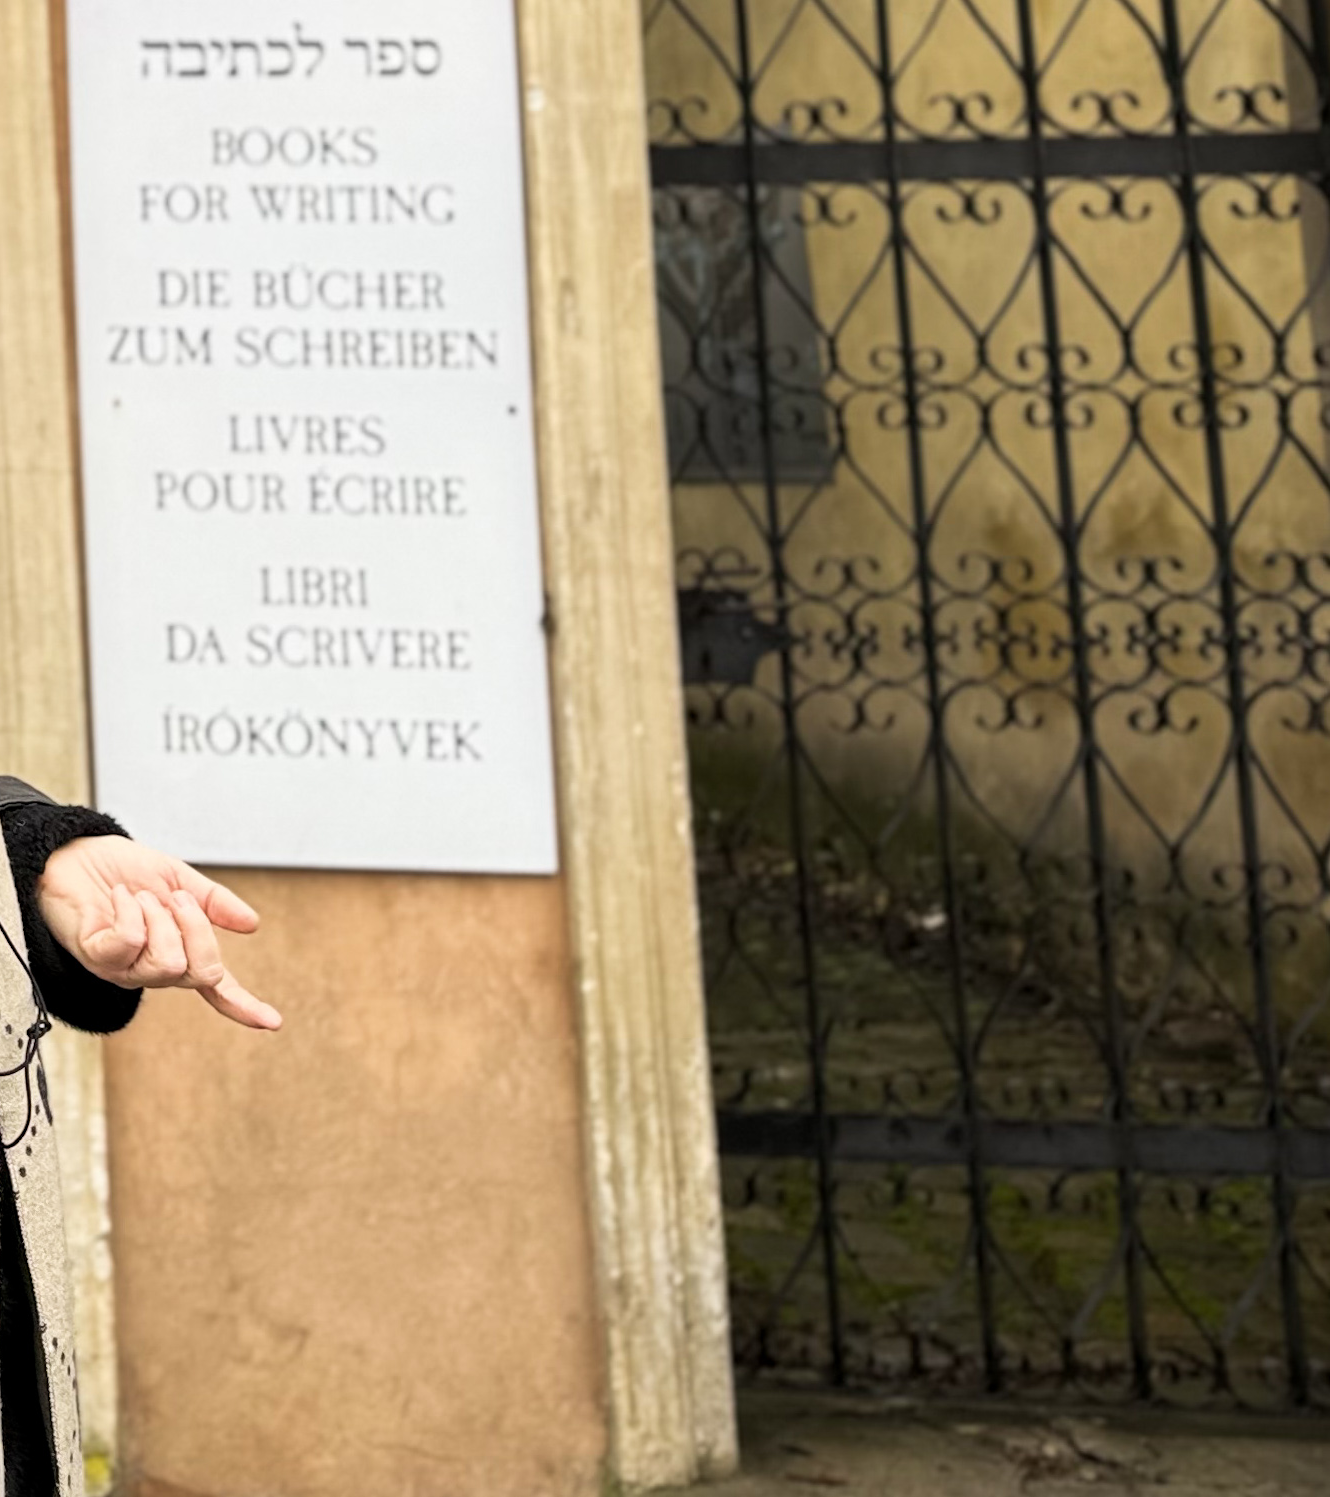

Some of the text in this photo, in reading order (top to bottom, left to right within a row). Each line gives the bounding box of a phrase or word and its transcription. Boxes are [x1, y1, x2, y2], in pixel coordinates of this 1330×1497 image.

[141, 23, 440, 78] ספר לכתיבה
[211, 128, 378, 166] BOOKS
[140, 184, 455, 224] FOR WRITING
[158, 264, 445, 310] DIE BÜCHER
[109, 327, 498, 369] ZUM SCHREIBEN
[229, 414, 386, 456] LIVRES
[154, 468, 466, 516] POUR ÉCRIRE
[260, 566, 368, 608] LIBRI
[166, 623, 471, 670] DA SCRIVERE
